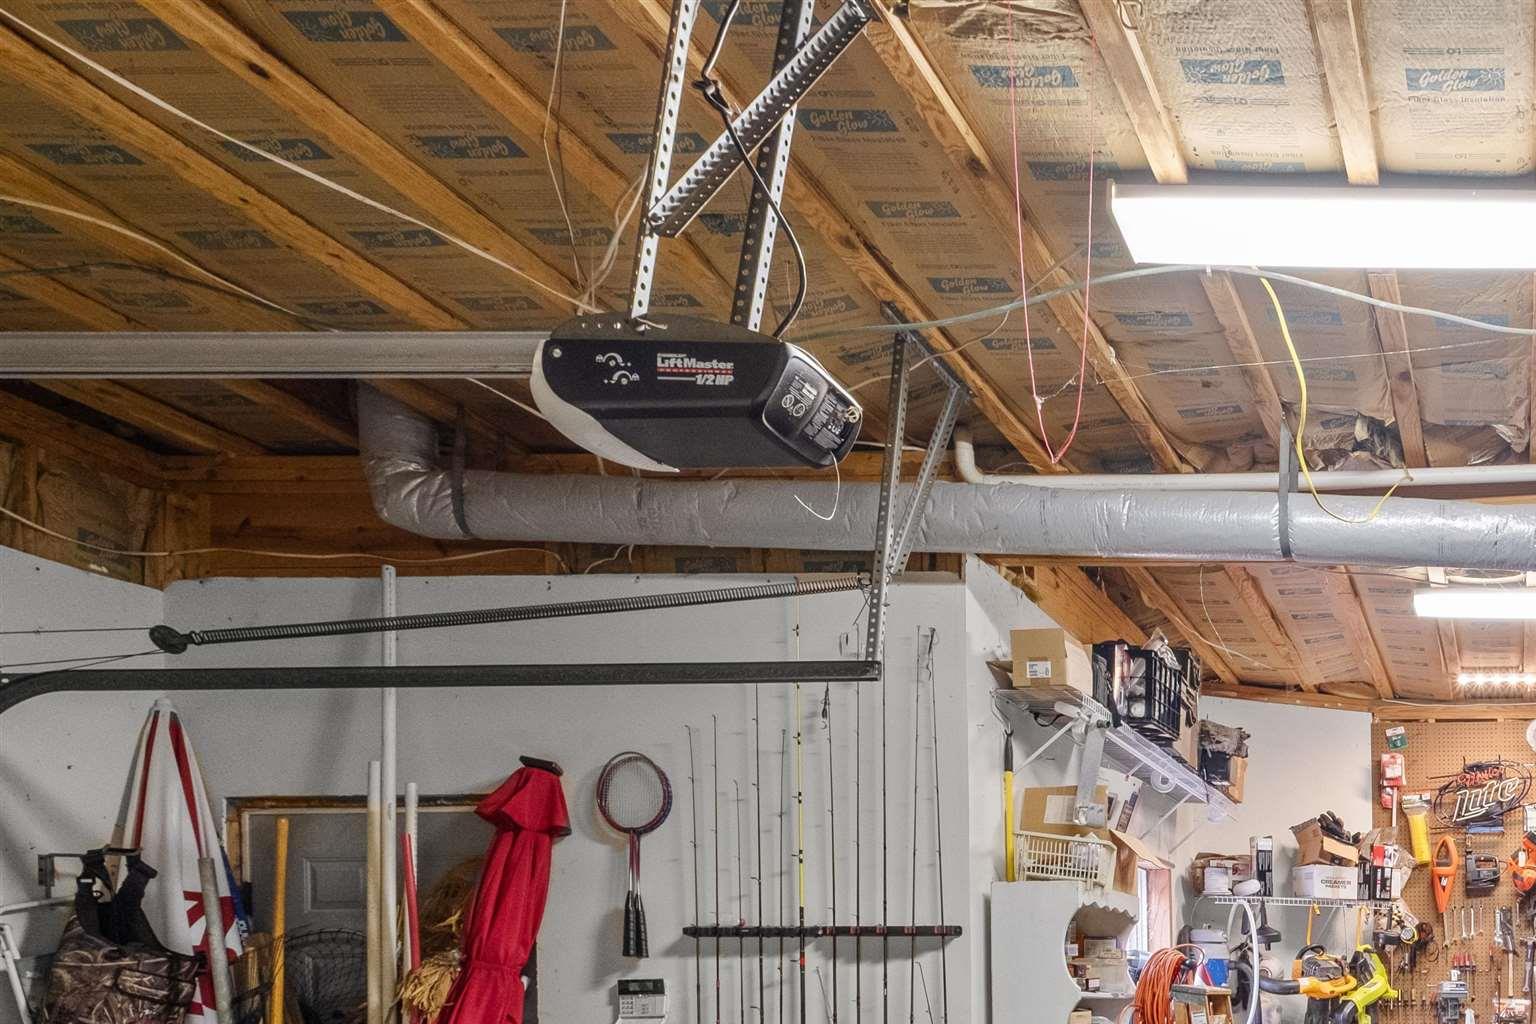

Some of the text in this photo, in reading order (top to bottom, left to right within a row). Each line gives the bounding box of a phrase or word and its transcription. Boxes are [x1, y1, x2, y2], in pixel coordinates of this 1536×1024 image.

[1419, 71, 1469, 88] Golden
[1442, 78, 1479, 93] Glow
[810, 110, 854, 127] Golden
[837, 117, 868, 135] Glow
[657, 357, 734, 369] LiftMaster
[695, 374, 716, 385] 1/2
